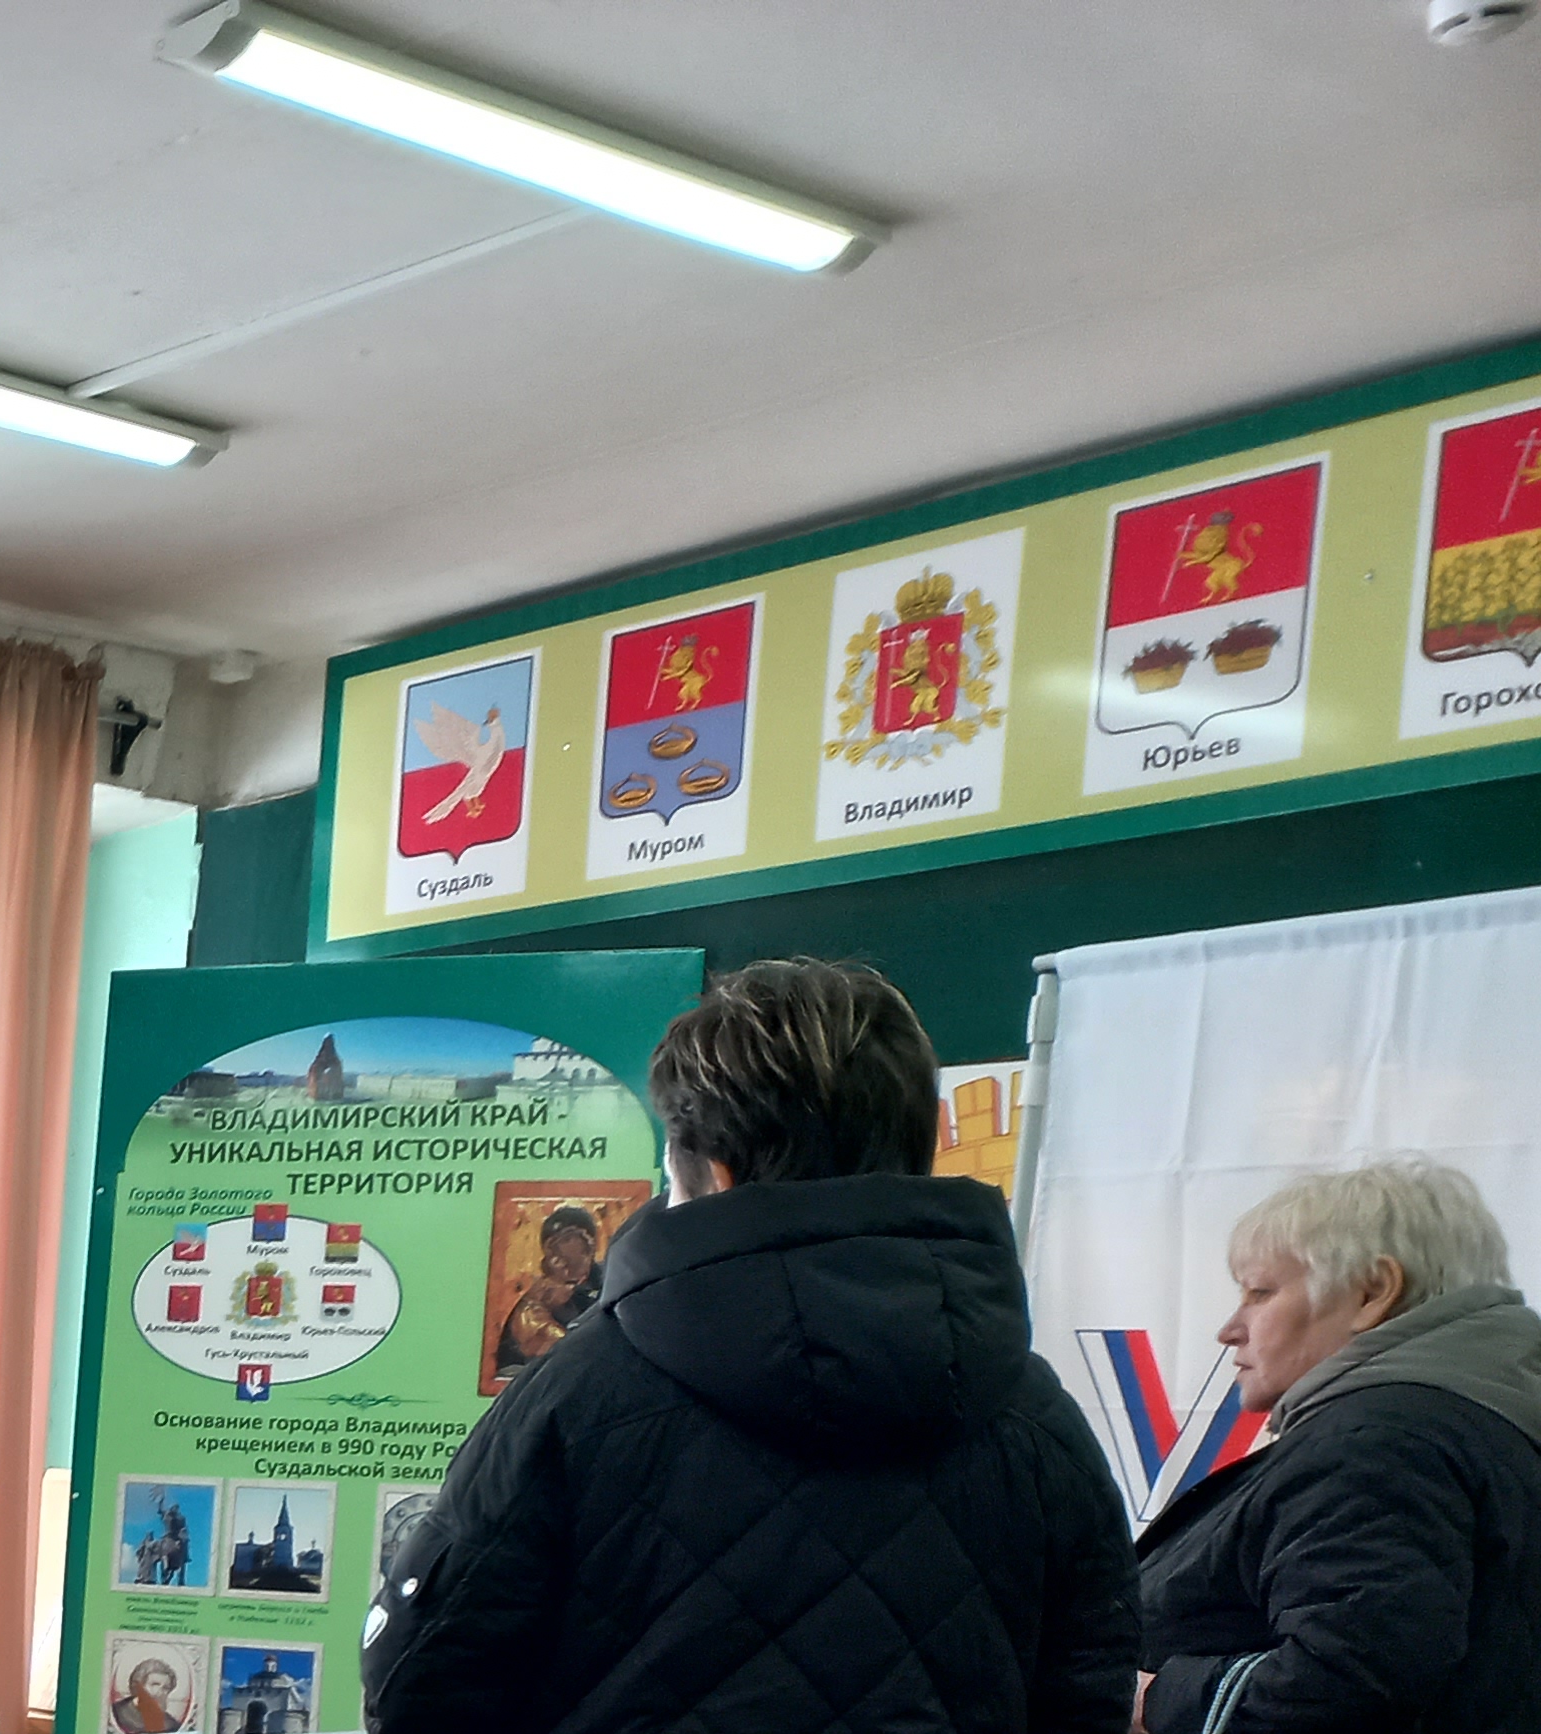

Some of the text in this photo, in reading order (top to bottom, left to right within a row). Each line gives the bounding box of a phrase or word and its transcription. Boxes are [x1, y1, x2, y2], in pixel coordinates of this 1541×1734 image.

[1142, 736, 1242, 771] Юрьев
[844, 786, 973, 825] Владимир
[626, 831, 706, 863] Муром
[416, 870, 494, 899] Суздаль
[211, 1102, 460, 1133] ВЛАДИМИРСКИЙ
[471, 1100, 549, 1128] КРАЙ
[169, 1136, 607, 1164] УНИКАЛЬНАЯ ИСТОРИЧЕСКАЯ
[128, 1187, 273, 1201] Города Золотого
[287, 1171, 474, 1195] ТЕРРИТОРИЯ
[127, 1203, 248, 1217] кольца России
[154, 1411, 467, 1438] Основание города Владимира
[196, 1437, 314, 1453] крещением
[321, 1442, 332, 1453] в
[338, 1439, 374, 1455] 990
[381, 1443, 427, 1460] году
[254, 1458, 443, 1480] Суздальской земл
